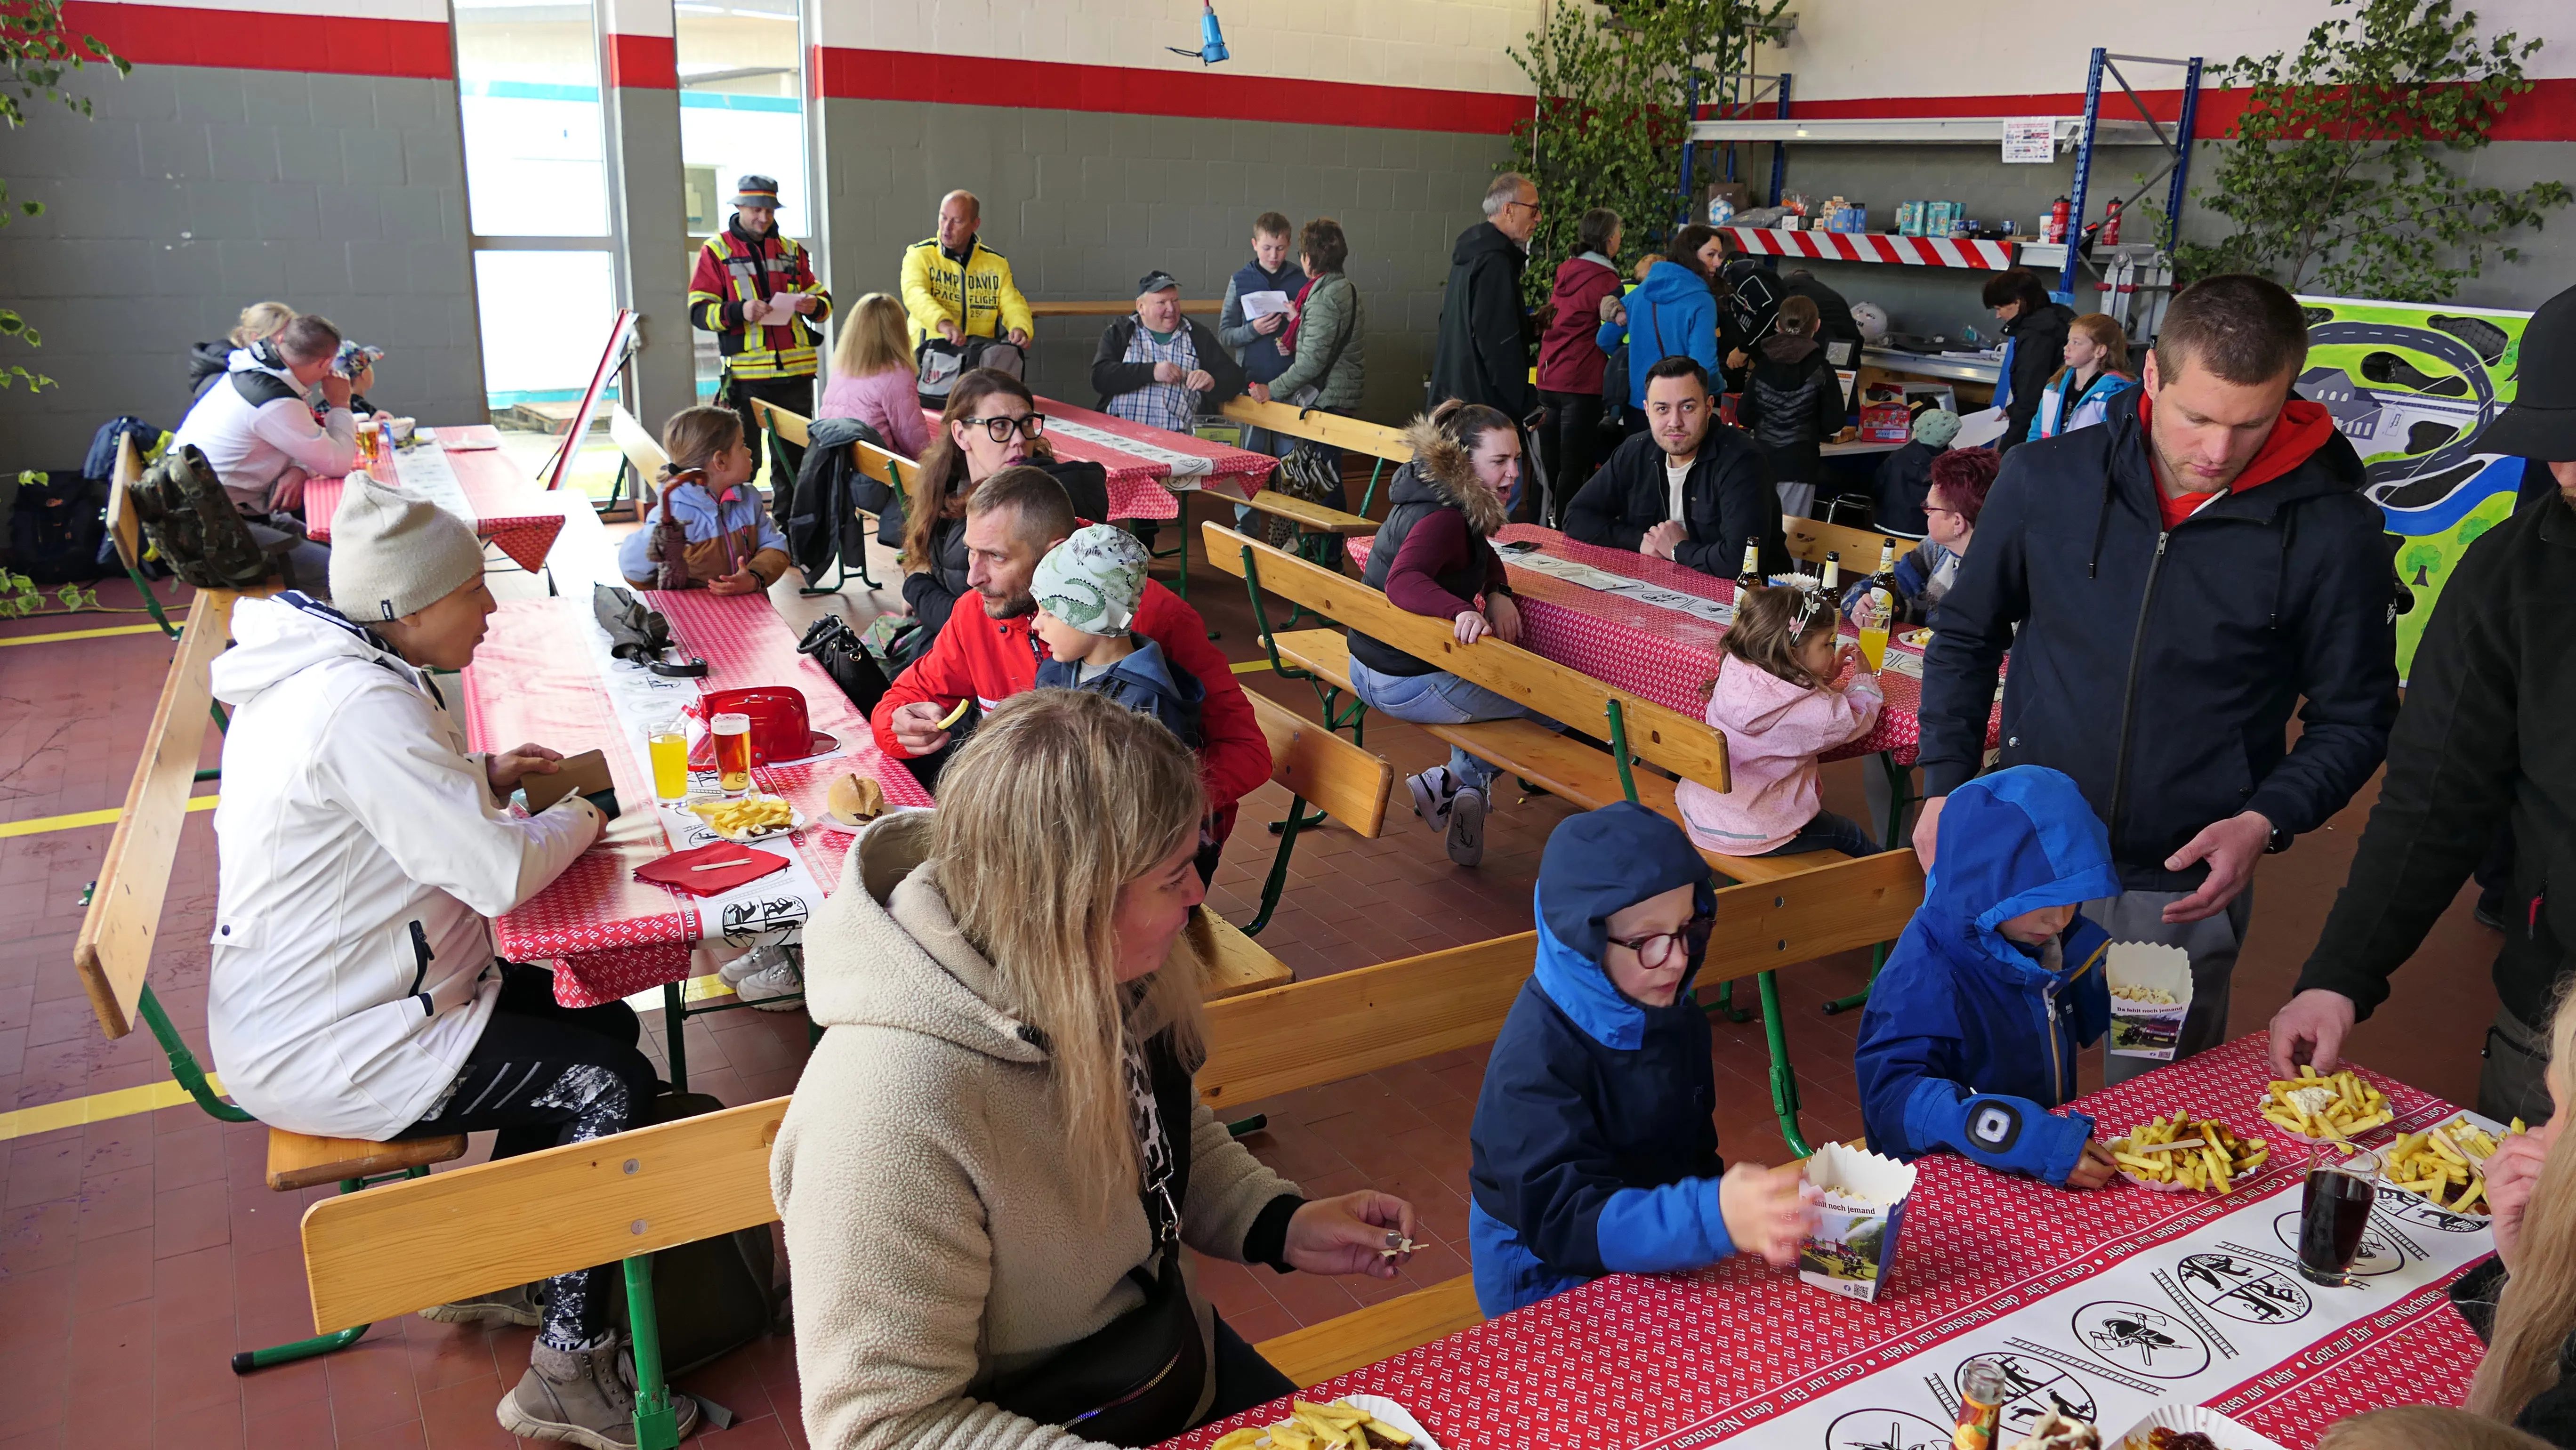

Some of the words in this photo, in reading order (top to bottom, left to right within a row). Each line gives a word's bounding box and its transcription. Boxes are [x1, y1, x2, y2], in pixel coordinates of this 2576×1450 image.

[929, 266, 959, 287] CAMP
[968, 275, 999, 290] DAVID
[969, 295, 998, 304] FLIGHT
[1911, 720, 1919, 729] 112
[632, 919, 647, 929] 112
[648, 919, 663, 930] 112
[664, 915, 678, 924] 112
[567, 929, 583, 939] 112
[584, 928, 599, 940] 112
[600, 924, 615, 934] 112
[616, 924, 632, 934] 112
[666, 927, 681, 938] 112
[518, 938, 534, 950] 112
[534, 934, 550, 944] 112
[551, 934, 567, 945] 112
[602, 937, 617, 948] 112
[619, 937, 633, 947] 112
[634, 932, 649, 943] 112
[650, 933, 665, 942] 112
[536, 947, 551, 956] 112
[569, 942, 584, 953] 112
[586, 942, 601, 952] 112
[612, 962, 623, 975] 112
[637, 968, 648, 982] 112
[625, 972, 636, 986] 112
[557, 984, 568, 997] 112
[569, 985, 582, 999] 112
[2159, 1006, 2183, 1014] jemand
[2423, 1108, 2448, 1120] Gott
[2409, 1116, 2427, 1126] zur
[2259, 1176, 2286, 1192] Gott
[1956, 1190, 1968, 1199] 112
[2242, 1186, 2261, 1198] zur
[1828, 1203, 1846, 1212] noch
[1848, 1205, 1876, 1215] jemand
[1956, 1205, 1968, 1216] 112
[2198, 1205, 2224, 1217] dem
[1975, 1213, 1988, 1224] 112
[2003, 1217, 2015, 1229] 112
[2151, 1210, 2205, 1240] Nächsten
[1989, 1225, 2002, 1236] 112
[2064, 1225, 2077, 1236] 112
[2133, 1232, 2155, 1247] zur
[2104, 1241, 2141, 1259] Wehr
[2062, 1263, 2096, 1280] Gott
[2045, 1273, 2066, 1286] zur
[1754, 1303, 1765, 1315] 112
[1770, 1297, 1781, 1308] 112
[1815, 1297, 1826, 1308] 112
[1990, 1295, 2019, 1310] dem
[1722, 1315, 1732, 1327] 112
[1738, 1309, 1749, 1321] 112
[1767, 1315, 1778, 1327] 112
[1783, 1309, 1795, 1321] 112
[1819, 1313, 1830, 1325] 112
[1935, 1306, 1996, 1335] Nächsten
[1705, 1322, 1716, 1334] 112
[1751, 1322, 1762, 1334] 112
[1833, 1326, 1844, 1337] 112
[1848, 1319, 1860, 1331] 112
[2304, 1345, 2338, 1365] Gott
[2333, 1337, 2354, 1353] zur
[2346, 1321, 2375, 1342] Ehr'
[2375, 1312, 2402, 1329] dem
[2391, 1288, 2445, 1319] Nächsten
[2423, 1321, 2440, 1333] 112
[1688, 1329, 1699, 1341] 112
[1734, 1328, 1745, 1341] 112
[1787, 1326, 1798, 1338] 112
[1915, 1331, 1938, 1345] zur
[2412, 1327, 2428, 1339] 112
[1754, 1339, 1765, 1352] 112
[1800, 1339, 1812, 1352] 112
[1817, 1333, 1828, 1345] 112
[1515, 1340, 1528, 1353] 112
[1700, 1342, 1712, 1354] 112
[1737, 1346, 1748, 1359] 112
[1784, 1346, 1795, 1359] 112
[1879, 1341, 1921, 1361] Wehr
[2387, 1340, 2404, 1353] 112
[1497, 1347, 1509, 1361] 112
[1767, 1353, 1779, 1366] 112
[2374, 1347, 2391, 1360] 112
[2412, 1351, 2429, 1364] 112
[1478, 1354, 1491, 1368] 112
[1515, 1359, 1528, 1371] 112
[2361, 1354, 2378, 1367] 112
[2399, 1358, 2416, 1371] 112
[1496, 1366, 1509, 1379] 112
[1827, 1363, 1865, 1381] Gott
[2349, 1361, 2366, 1374] 112
[2387, 1365, 2404, 1378] 112
[1477, 1374, 1490, 1387] 112
[1582, 1369, 1594, 1382] 112
[2336, 1368, 2352, 1381] 112
[2374, 1372, 2391, 1385] 112
[1506, 1380, 1520, 1394] 112
[1563, 1376, 1576, 1389] 112
[1806, 1378, 1830, 1392] zur
[2243, 1385, 2266, 1401] zur
[2258, 1368, 2297, 1389] Wehr
[2322, 1376, 2339, 1389] 112
[2361, 1379, 2378, 1393] 112
[1594, 1383, 1606, 1396] 112
[2309, 1383, 2326, 1396] 112
[2348, 1387, 2365, 1401] 112
[2295, 1390, 2312, 1404] 112
[2334, 1394, 2352, 1408] 112
[1740, 1401, 1774, 1419] dem
[2282, 1398, 2299, 1411] 112
[2321, 1402, 2338, 1416] 112
[2268, 1405, 2285, 1418] 112
[2308, 1409, 2325, 1424] 112
[2254, 1412, 2271, 1426] 112
[2294, 1416, 2311, 1431] 112
[1673, 1414, 1746, 1446] Nächsten
